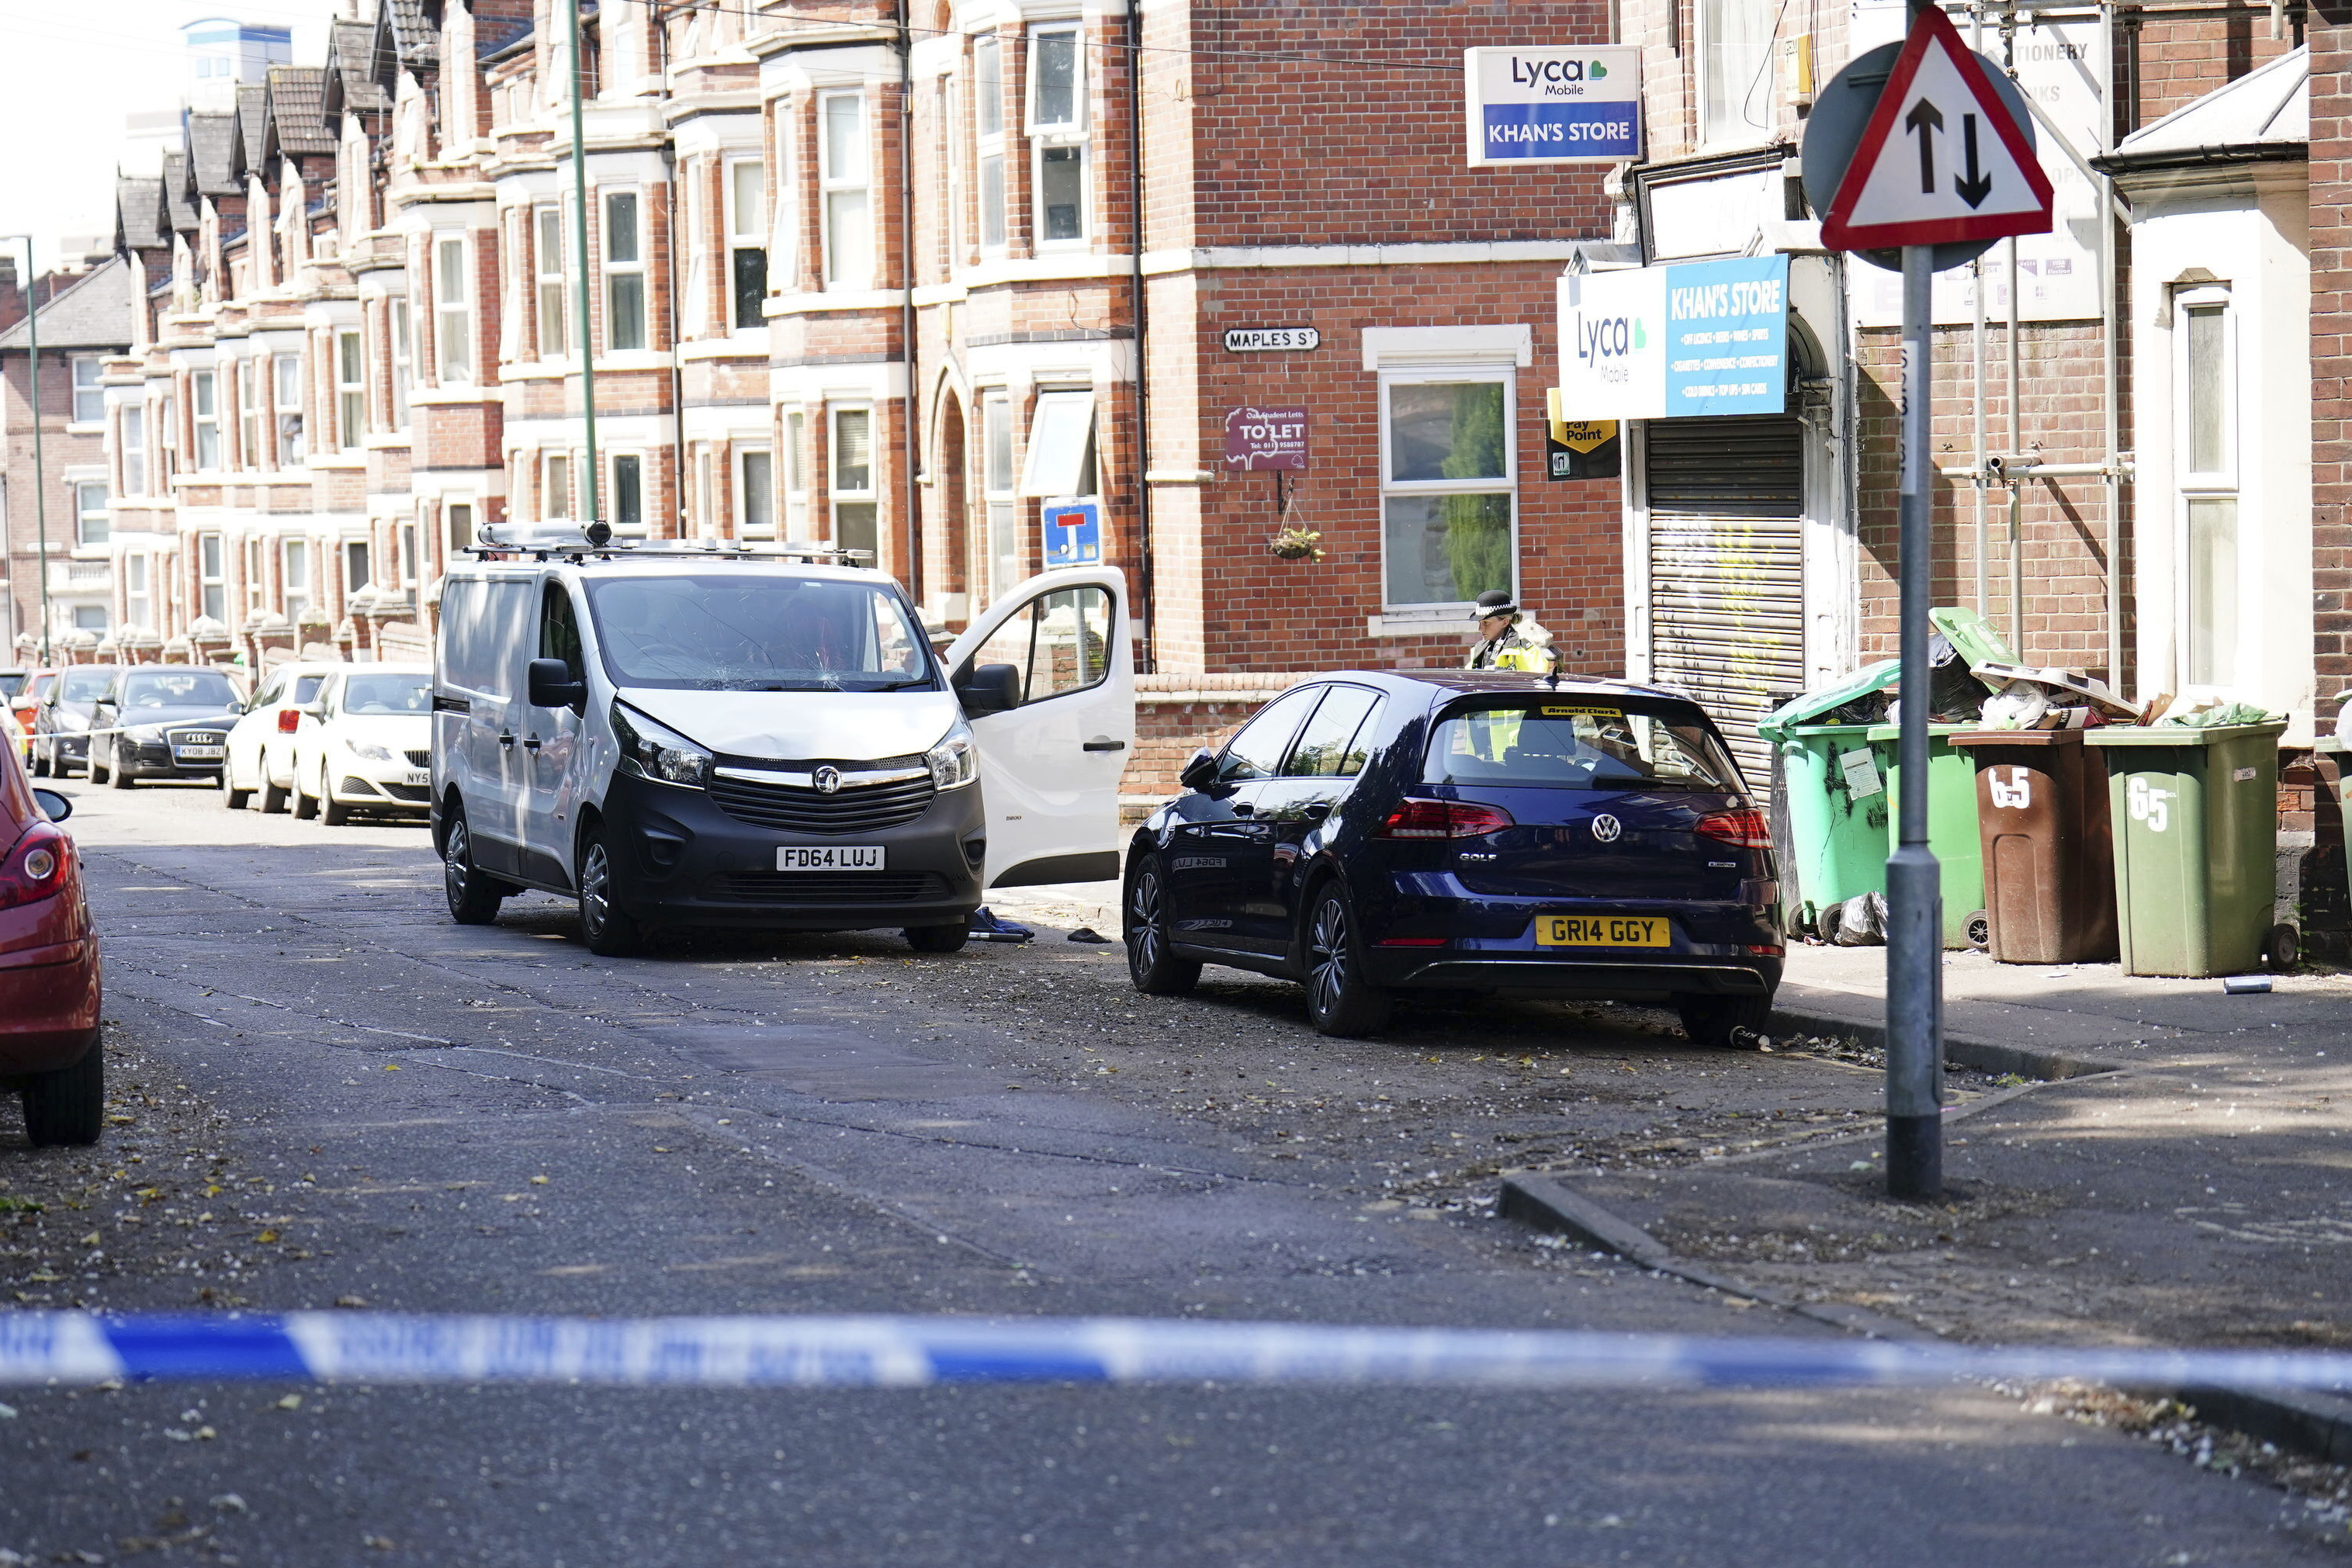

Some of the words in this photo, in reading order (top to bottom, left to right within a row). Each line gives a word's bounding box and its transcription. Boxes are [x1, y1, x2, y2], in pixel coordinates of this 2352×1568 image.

[2013, 43, 2088, 63] TIONERY
[1512, 57, 1583, 88] Lyca
[1545, 85, 1584, 96] Mobile
[1489, 123, 1564, 143] KHAN'S
[1568, 122, 1630, 140] STORE
[1671, 283, 1729, 320] KHAN'S
[1731, 279, 1780, 316] STORE
[1230, 333, 1291, 347] MAPLES
[1578, 311, 1628, 369] Lyca
[1601, 365, 1628, 384] Mobile
[1239, 424, 1266, 439] TO
[1271, 424, 1304, 438] LET
[1566, 421, 1588, 431] Pay
[1567, 429, 1602, 441] Point
[407, 773, 431, 784] NY5
[1988, 767, 2030, 809] 65
[2129, 777, 2167, 832] 65
[785, 850, 834, 867] FD64
[840, 849, 877, 867] LUJ
[1460, 853, 1497, 862] GOLF
[1552, 919, 1604, 942] GR14
[1610, 920, 1654, 943] GGY
[1737, 1030, 1758, 1040] KFC
